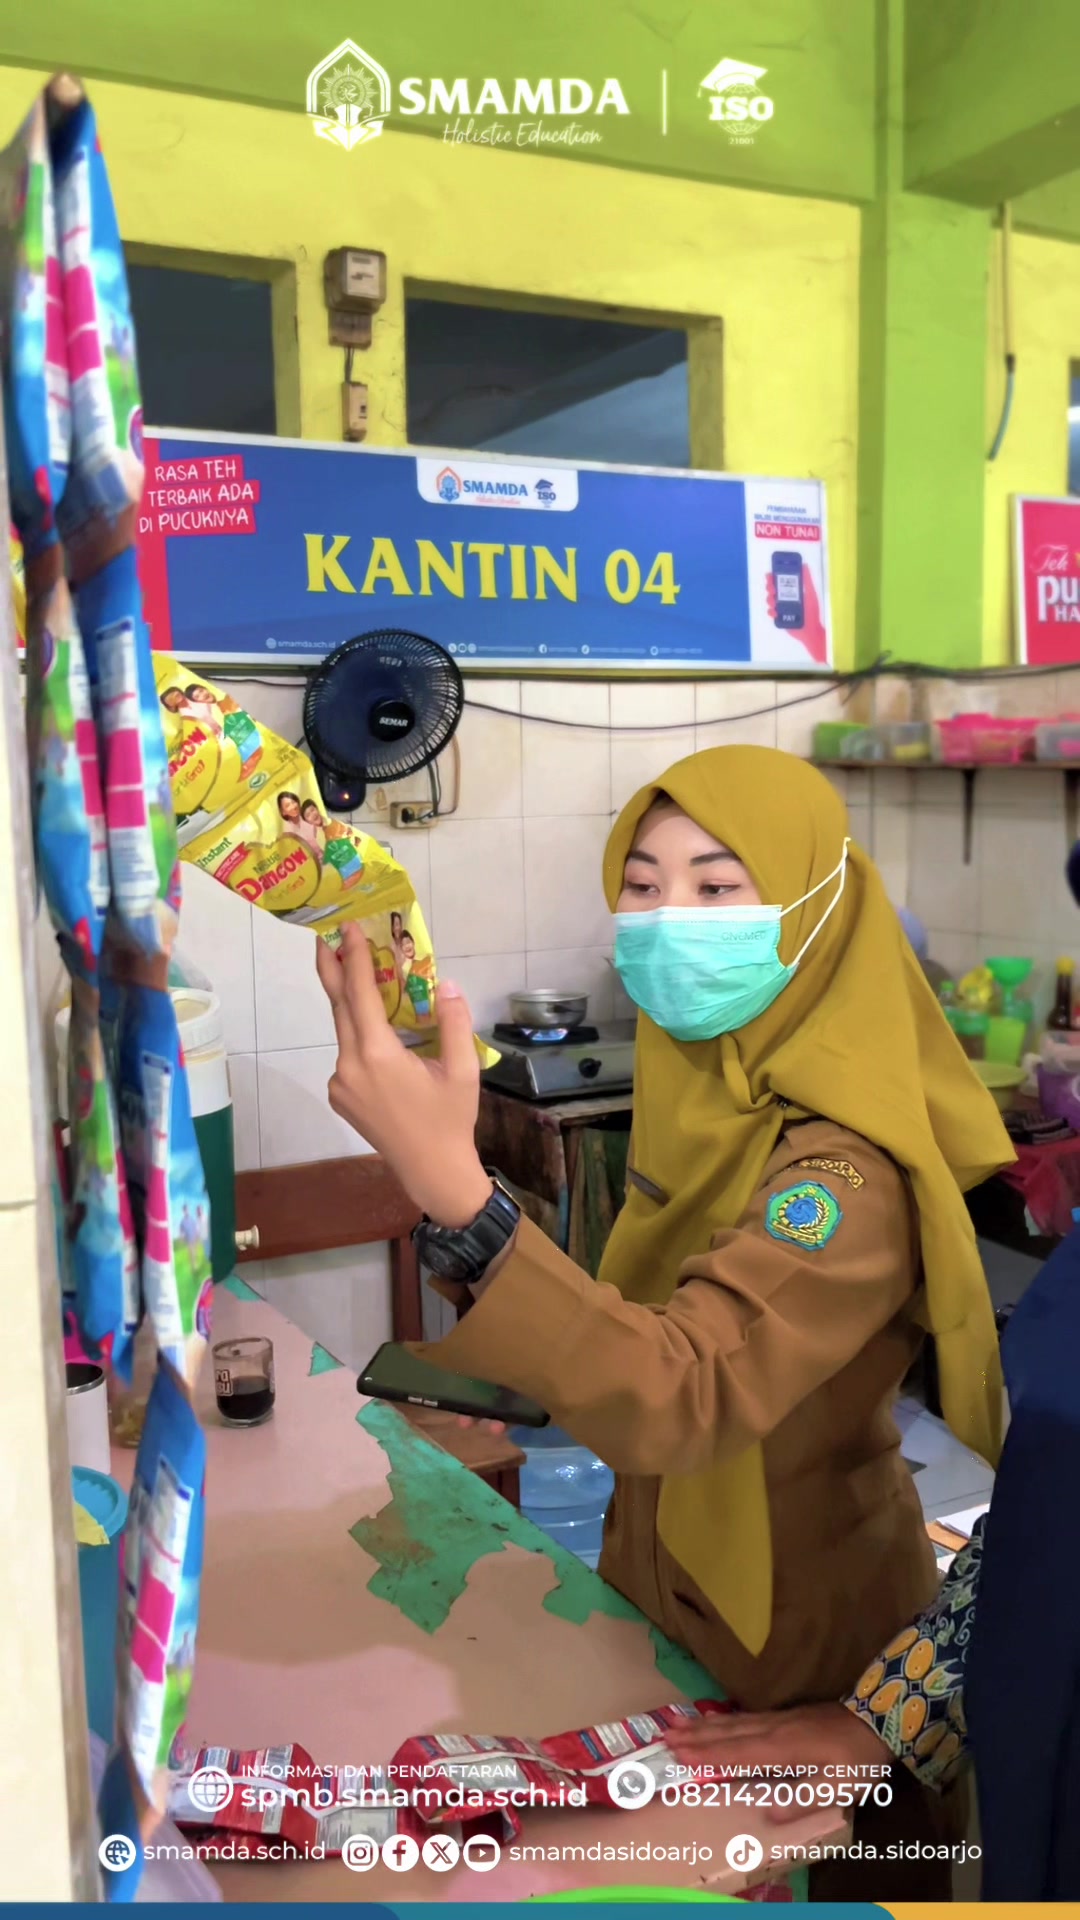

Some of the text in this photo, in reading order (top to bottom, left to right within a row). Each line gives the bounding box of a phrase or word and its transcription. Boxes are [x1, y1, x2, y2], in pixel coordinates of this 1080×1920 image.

[154, 459, 236, 481] RASA TEH
[147, 483, 254, 508] TERBAIK ADA
[463, 480, 528, 496] SMAMDA
[537, 491, 556, 500] ISO
[139, 507, 249, 533] DI PUCUKNYA
[756, 523, 818, 538] NON TUNAI
[304, 533, 681, 605] KANTIN 04
[782, 614, 796, 622] PAY
[379, 716, 409, 727] SEMAR
[197, 837, 232, 867] Instant
